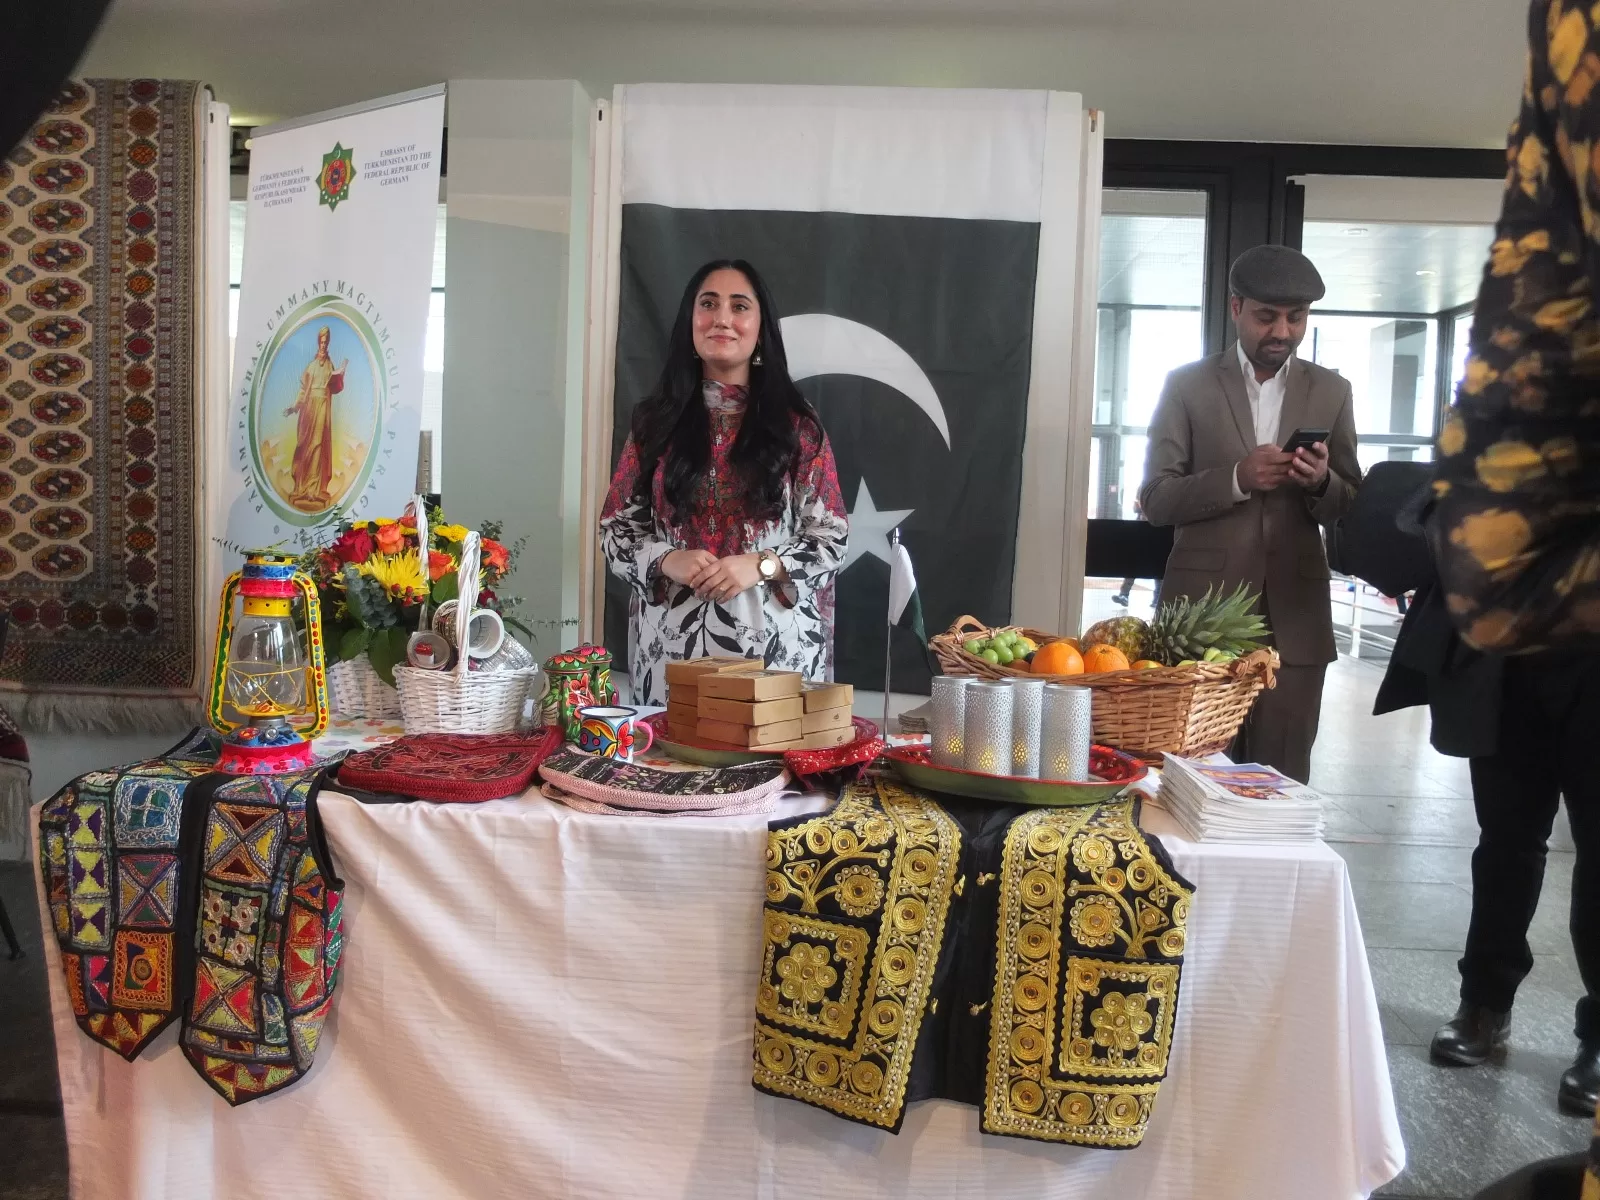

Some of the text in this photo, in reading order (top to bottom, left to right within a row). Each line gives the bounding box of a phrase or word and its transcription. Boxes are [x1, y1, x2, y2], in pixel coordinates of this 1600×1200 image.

[380, 143, 417, 157] EMBASSY OF
[364, 151, 432, 170] TURKMENISTAN TO THE
[364, 161, 431, 180] FEDERAL REPUBLIC OF
[380, 175, 409, 187] GERMANY
[266, 280, 330, 331] UMMANY
[336, 280, 400, 412] MAGTYMGULY
